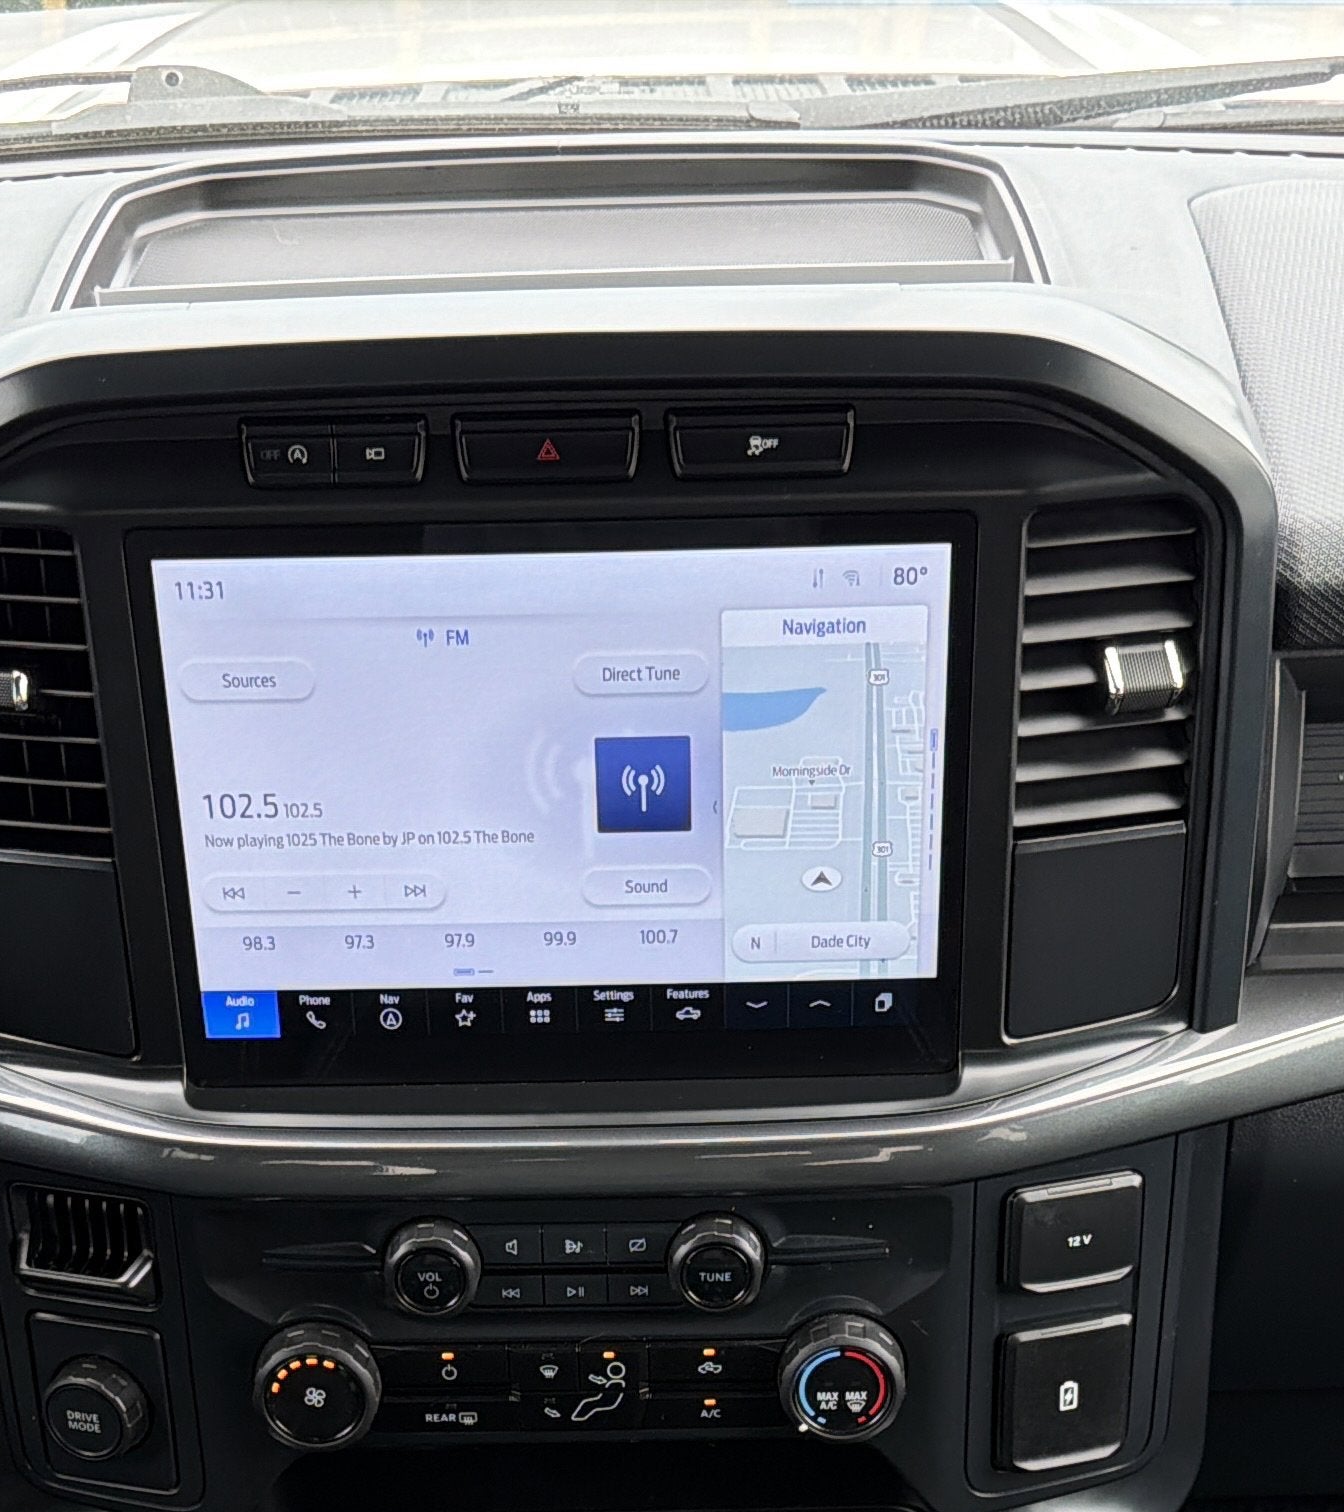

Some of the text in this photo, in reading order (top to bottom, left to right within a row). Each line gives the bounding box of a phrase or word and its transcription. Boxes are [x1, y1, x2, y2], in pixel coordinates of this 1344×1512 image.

[762, 438, 779, 449] OFF
[260, 449, 281, 461] OFF
[893, 566, 928, 586] 80°
[174, 580, 225, 600] 11:31
[782, 619, 867, 638] Navigation
[445, 629, 470, 646] FM
[221, 672, 277, 689] Sources
[601, 666, 681, 682] Direct Tune
[772, 764, 851, 778] Morningside Dr
[202, 793, 323, 819] 102.5 102.5
[205, 830, 535, 850] Now playing 1025 The Bone by JP on 102.5 The Bone
[624, 878, 668, 894] Sound
[242, 929, 678, 951] 98.3 97.3 97.9 99.9 100.7
[750, 937, 761, 950] N
[811, 934, 871, 952] Dade City
[298, 994, 331, 1006] Phone
[379, 993, 400, 1005] Nav
[455, 993, 474, 1004] Fav
[526, 991, 552, 1004] Apps
[593, 989, 635, 1003] Settings
[666, 988, 710, 1000] Features
[225, 995, 255, 1007] Audio
[1067, 1233, 1093, 1248] 12 V
[417, 1272, 442, 1283] VOL
[699, 1272, 732, 1283] TUNE
[816, 1391, 839, 1401] MAX
[845, 1390, 868, 1400] MAX
[819, 1400, 838, 1411] A/C
[66, 1409, 100, 1424] DRIVE
[425, 1413, 457, 1423] REAR
[700, 1408, 721, 1419] A/C
[68, 1420, 102, 1434] MODE
